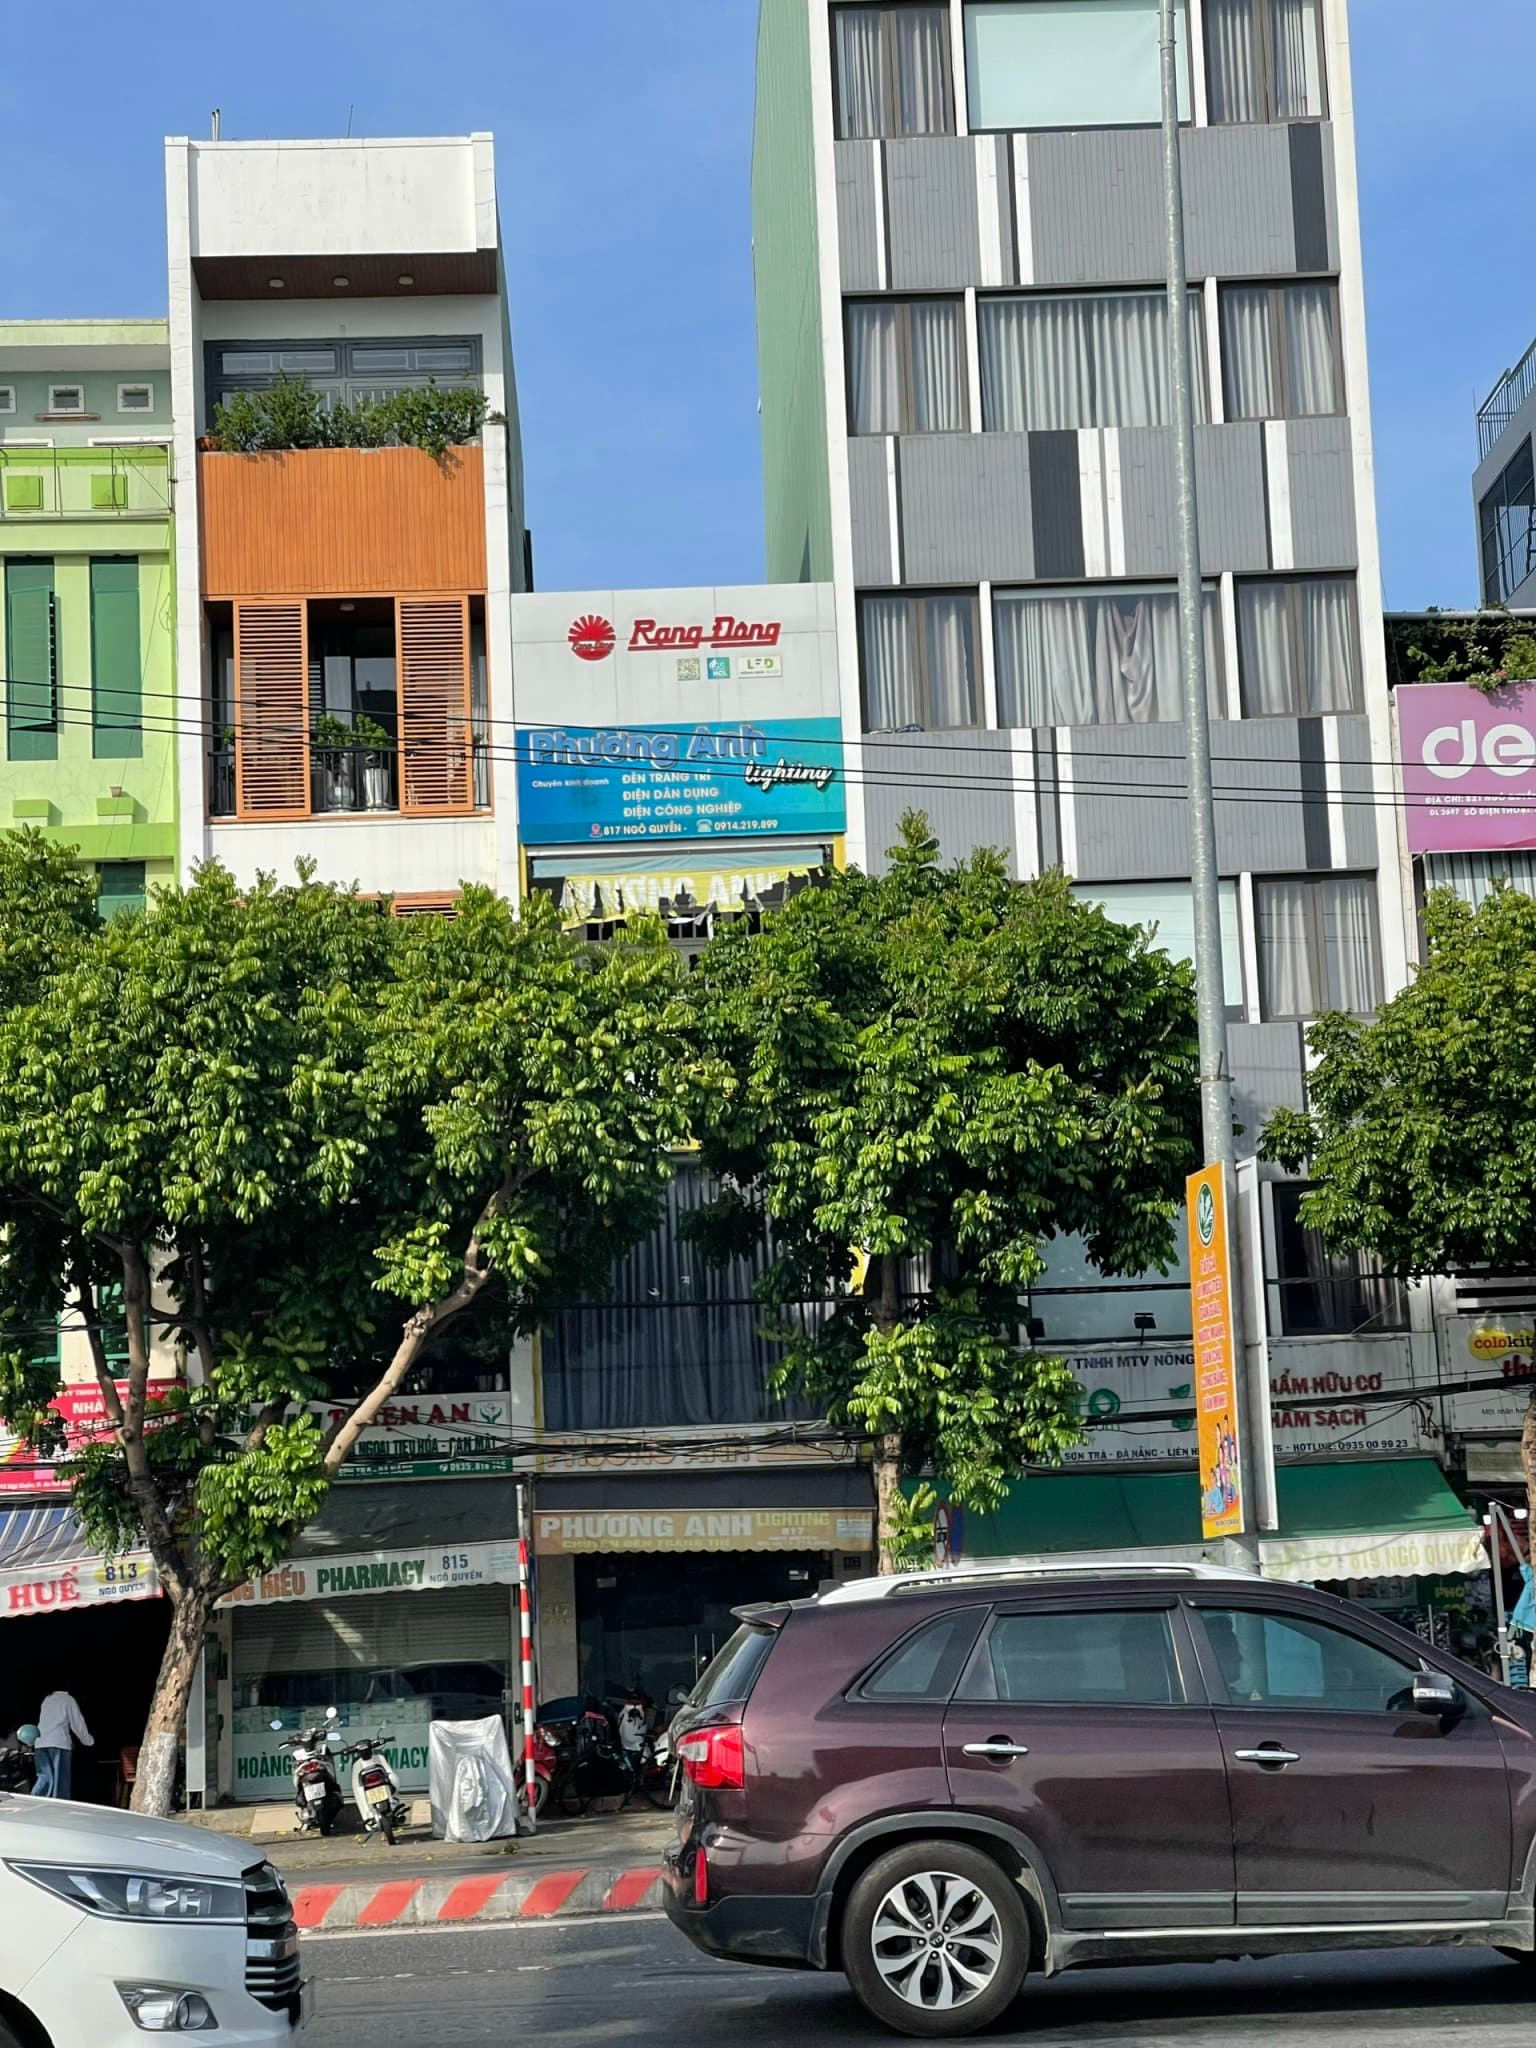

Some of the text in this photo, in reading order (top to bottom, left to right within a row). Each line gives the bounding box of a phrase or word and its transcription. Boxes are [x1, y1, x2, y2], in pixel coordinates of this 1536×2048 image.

[529, 724, 768, 771] Phương Anh
[622, 771, 646, 785] ĐÈN
[622, 786, 720, 804] ĐIỆN DÂN DỤNG
[623, 800, 743, 820] ĐIỆN CÔNG NGHIỆP
[603, 825, 620, 836] 817
[623, 822, 647, 835] NGÔ
[713, 819, 779, 832] 0914.219.899
[1075, 1351, 1195, 1370] TNHH MTV NÔNG
[1312, 1371, 1353, 1394] HỮU
[1355, 1371, 1383, 1392] CƠ
[426, 1402, 470, 1424] AN
[1315, 1408, 1367, 1430] SẠCH
[1064, 1451, 1085, 1461] SƠN
[1167, 1446, 1188, 1456] LIÊN
[1338, 1440, 1364, 1450] 0935
[1366, 1440, 1379, 1449] 00
[1382, 1440, 1395, 1449] 99
[1395, 1439, 1409, 1448] 23
[540, 1512, 752, 1539] PHƯƠNG ANH
[756, 1511, 831, 1527] LIGHTING
[105, 1562, 138, 1581] 813
[442, 1554, 469, 1570] 815
[7, 1566, 80, 1609] HUẾ
[261, 1562, 307, 1599] HIẾU
[317, 1559, 427, 1593] PHARMACY
[237, 1752, 292, 1779] HOÀNG
